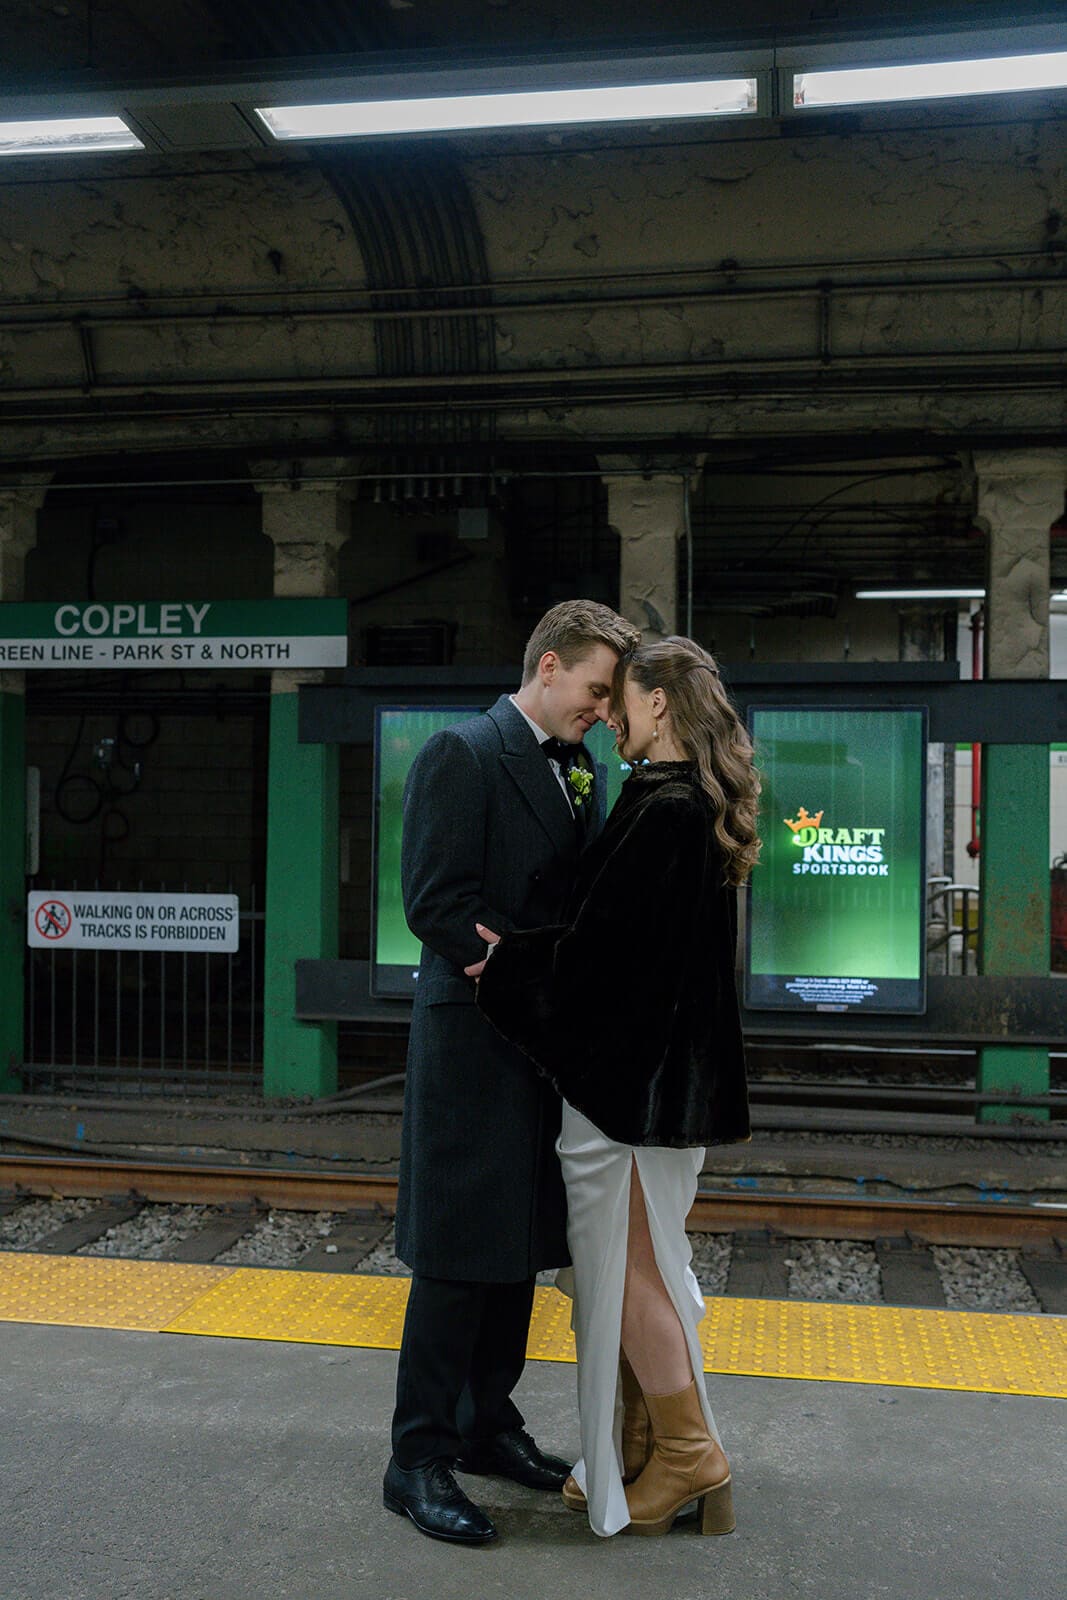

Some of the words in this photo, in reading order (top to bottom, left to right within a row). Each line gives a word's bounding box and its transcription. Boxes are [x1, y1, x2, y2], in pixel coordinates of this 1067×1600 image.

[54, 604, 211, 636] COPLEY
[51, 645, 94, 661] LINE
[112, 644, 164, 660] PARK
[170, 644, 195, 660] ST
[200, 644, 213, 660] &
[220, 643, 290, 660] NORTH
[793, 825, 886, 847] DRAFT
[802, 843, 884, 863] KINGS
[793, 863, 889, 877] SPORTSBOOK
[73, 904, 133, 920] WALKING
[135, 905, 155, 920] ON
[157, 905, 176, 921] OR
[179, 905, 234, 922] ACROSS
[80, 923, 132, 939] TRACKS
[134, 924, 148, 939] IS
[150, 924, 226, 941] FORBIDDEN
